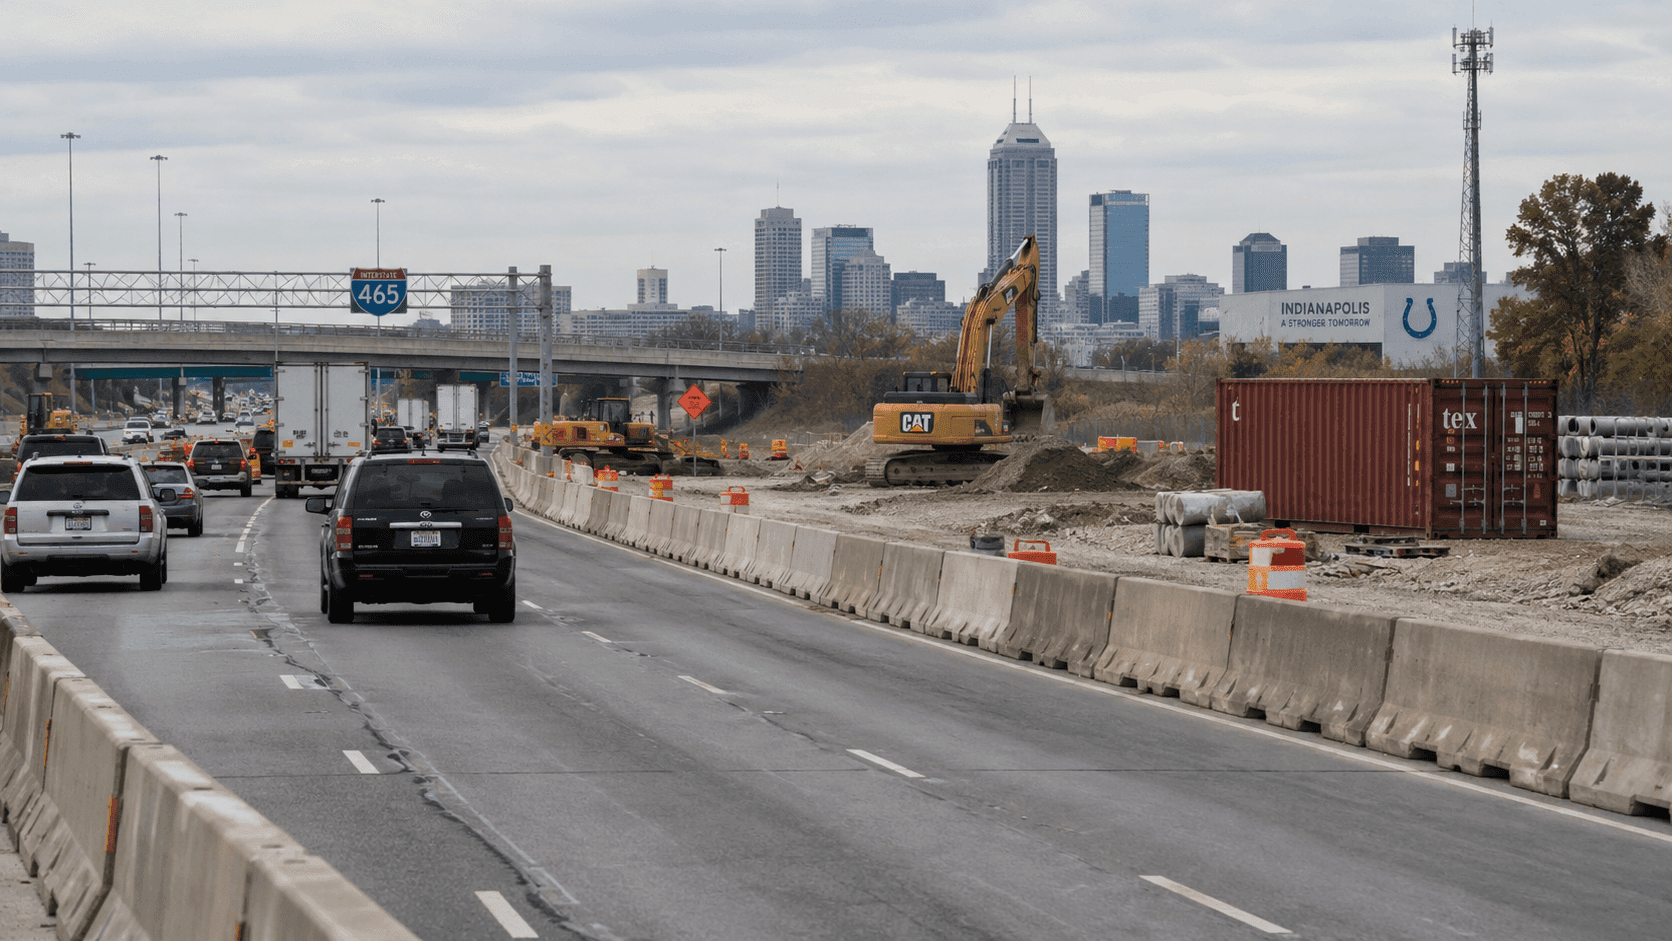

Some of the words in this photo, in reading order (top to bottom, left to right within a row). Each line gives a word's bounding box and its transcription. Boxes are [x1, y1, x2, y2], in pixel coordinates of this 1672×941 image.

[358, 284, 399, 304] 465
[1281, 302, 1370, 315] INDIANAPOLIS
[1280, 319, 1287, 328] A
[902, 414, 931, 432] CAT
[1442, 408, 1478, 430] tex
